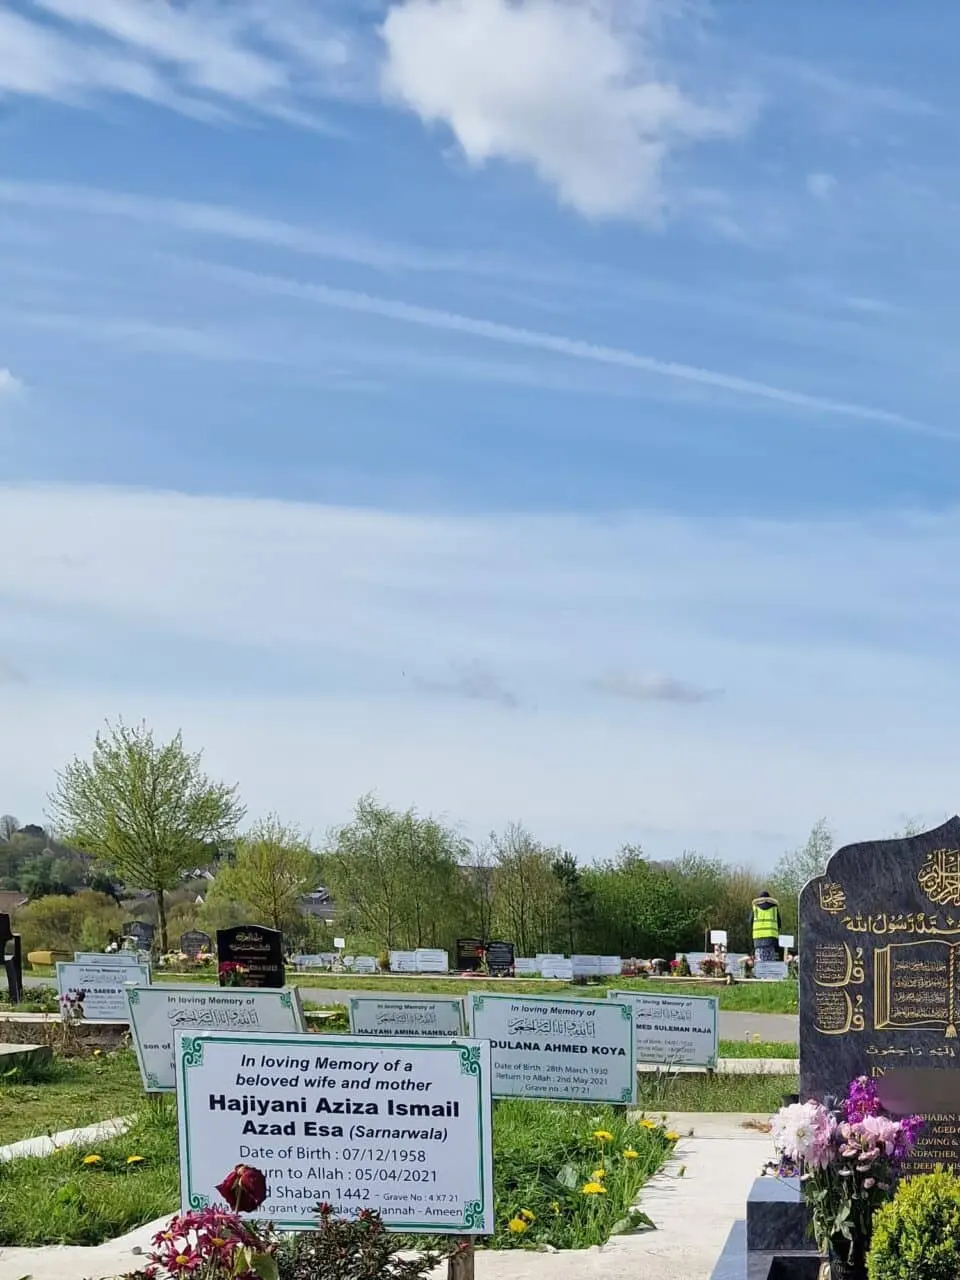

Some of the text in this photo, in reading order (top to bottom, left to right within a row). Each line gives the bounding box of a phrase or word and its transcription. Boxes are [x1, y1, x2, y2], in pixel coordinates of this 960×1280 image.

[179, 995, 206, 1005] loving
[208, 996, 243, 1007] Memory
[511, 1004, 596, 1018] In loving Memory of
[636, 1023, 652, 1031] MED
[544, 1043, 588, 1054] AHMED
[591, 1046, 627, 1056] KOYA
[241, 1054, 413, 1074] In loving Memory of a
[494, 1061, 512, 1070] Date
[523, 1063, 541, 1071] Birth
[565, 1065, 588, 1074] March
[236, 1073, 433, 1091] beloved wife and mother
[496, 1072, 521, 1080] Return
[532, 1073, 551, 1081] Allah
[557, 1075, 572, 1083] 2nd
[573, 1077, 589, 1085] May
[589, 1077, 609, 1085] 2021
[525, 1083, 547, 1092] Grave
[209, 1094, 459, 1117] Hajiyani Aziza Ismail
[242, 1120, 448, 1143] Azad Esa (Sarnarwala)
[239, 1145, 274, 1158] Date
[278, 1146, 293, 1159] of
[297, 1146, 331, 1160] Birth
[342, 1148, 426, 1162] 07/12/1958
[288, 1170, 303, 1179] to
[307, 1167, 344, 1180] Allah
[355, 1168, 437, 1183] 05/04/2021
[276, 1185, 331, 1199] Shaban
[336, 1188, 370, 1200] 1442
[383, 1192, 408, 1201] Grave
[410, 1193, 422, 1201] No
[268, 1204, 298, 1214] grant
[424, 1207, 463, 1217] Ameen
